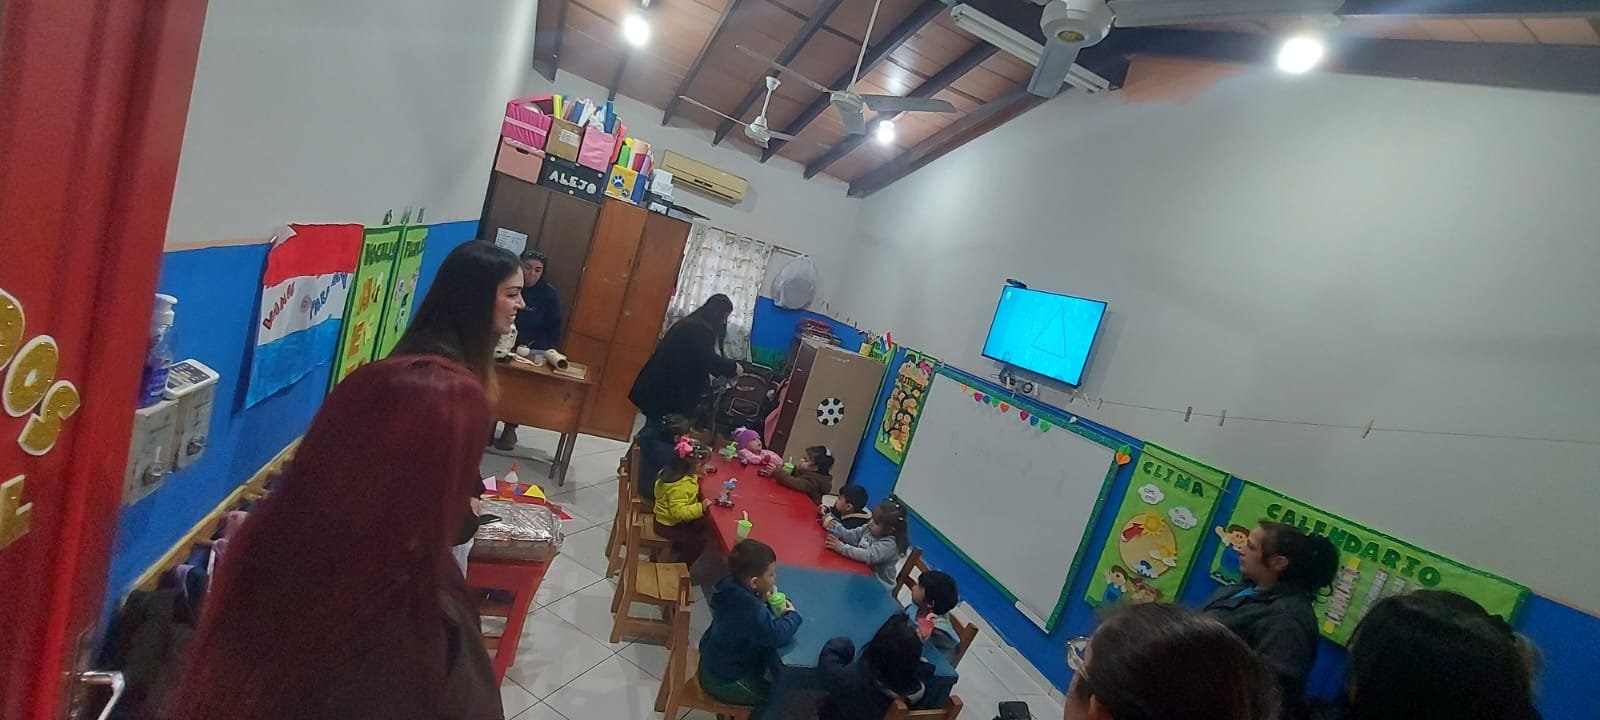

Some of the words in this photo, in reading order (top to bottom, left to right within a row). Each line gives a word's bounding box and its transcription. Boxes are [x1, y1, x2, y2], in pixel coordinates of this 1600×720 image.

[549, 170, 597, 195] ALEJO
[1143, 461, 1204, 497] CLIMA
[1266, 503, 1441, 587] CALENDARIO
